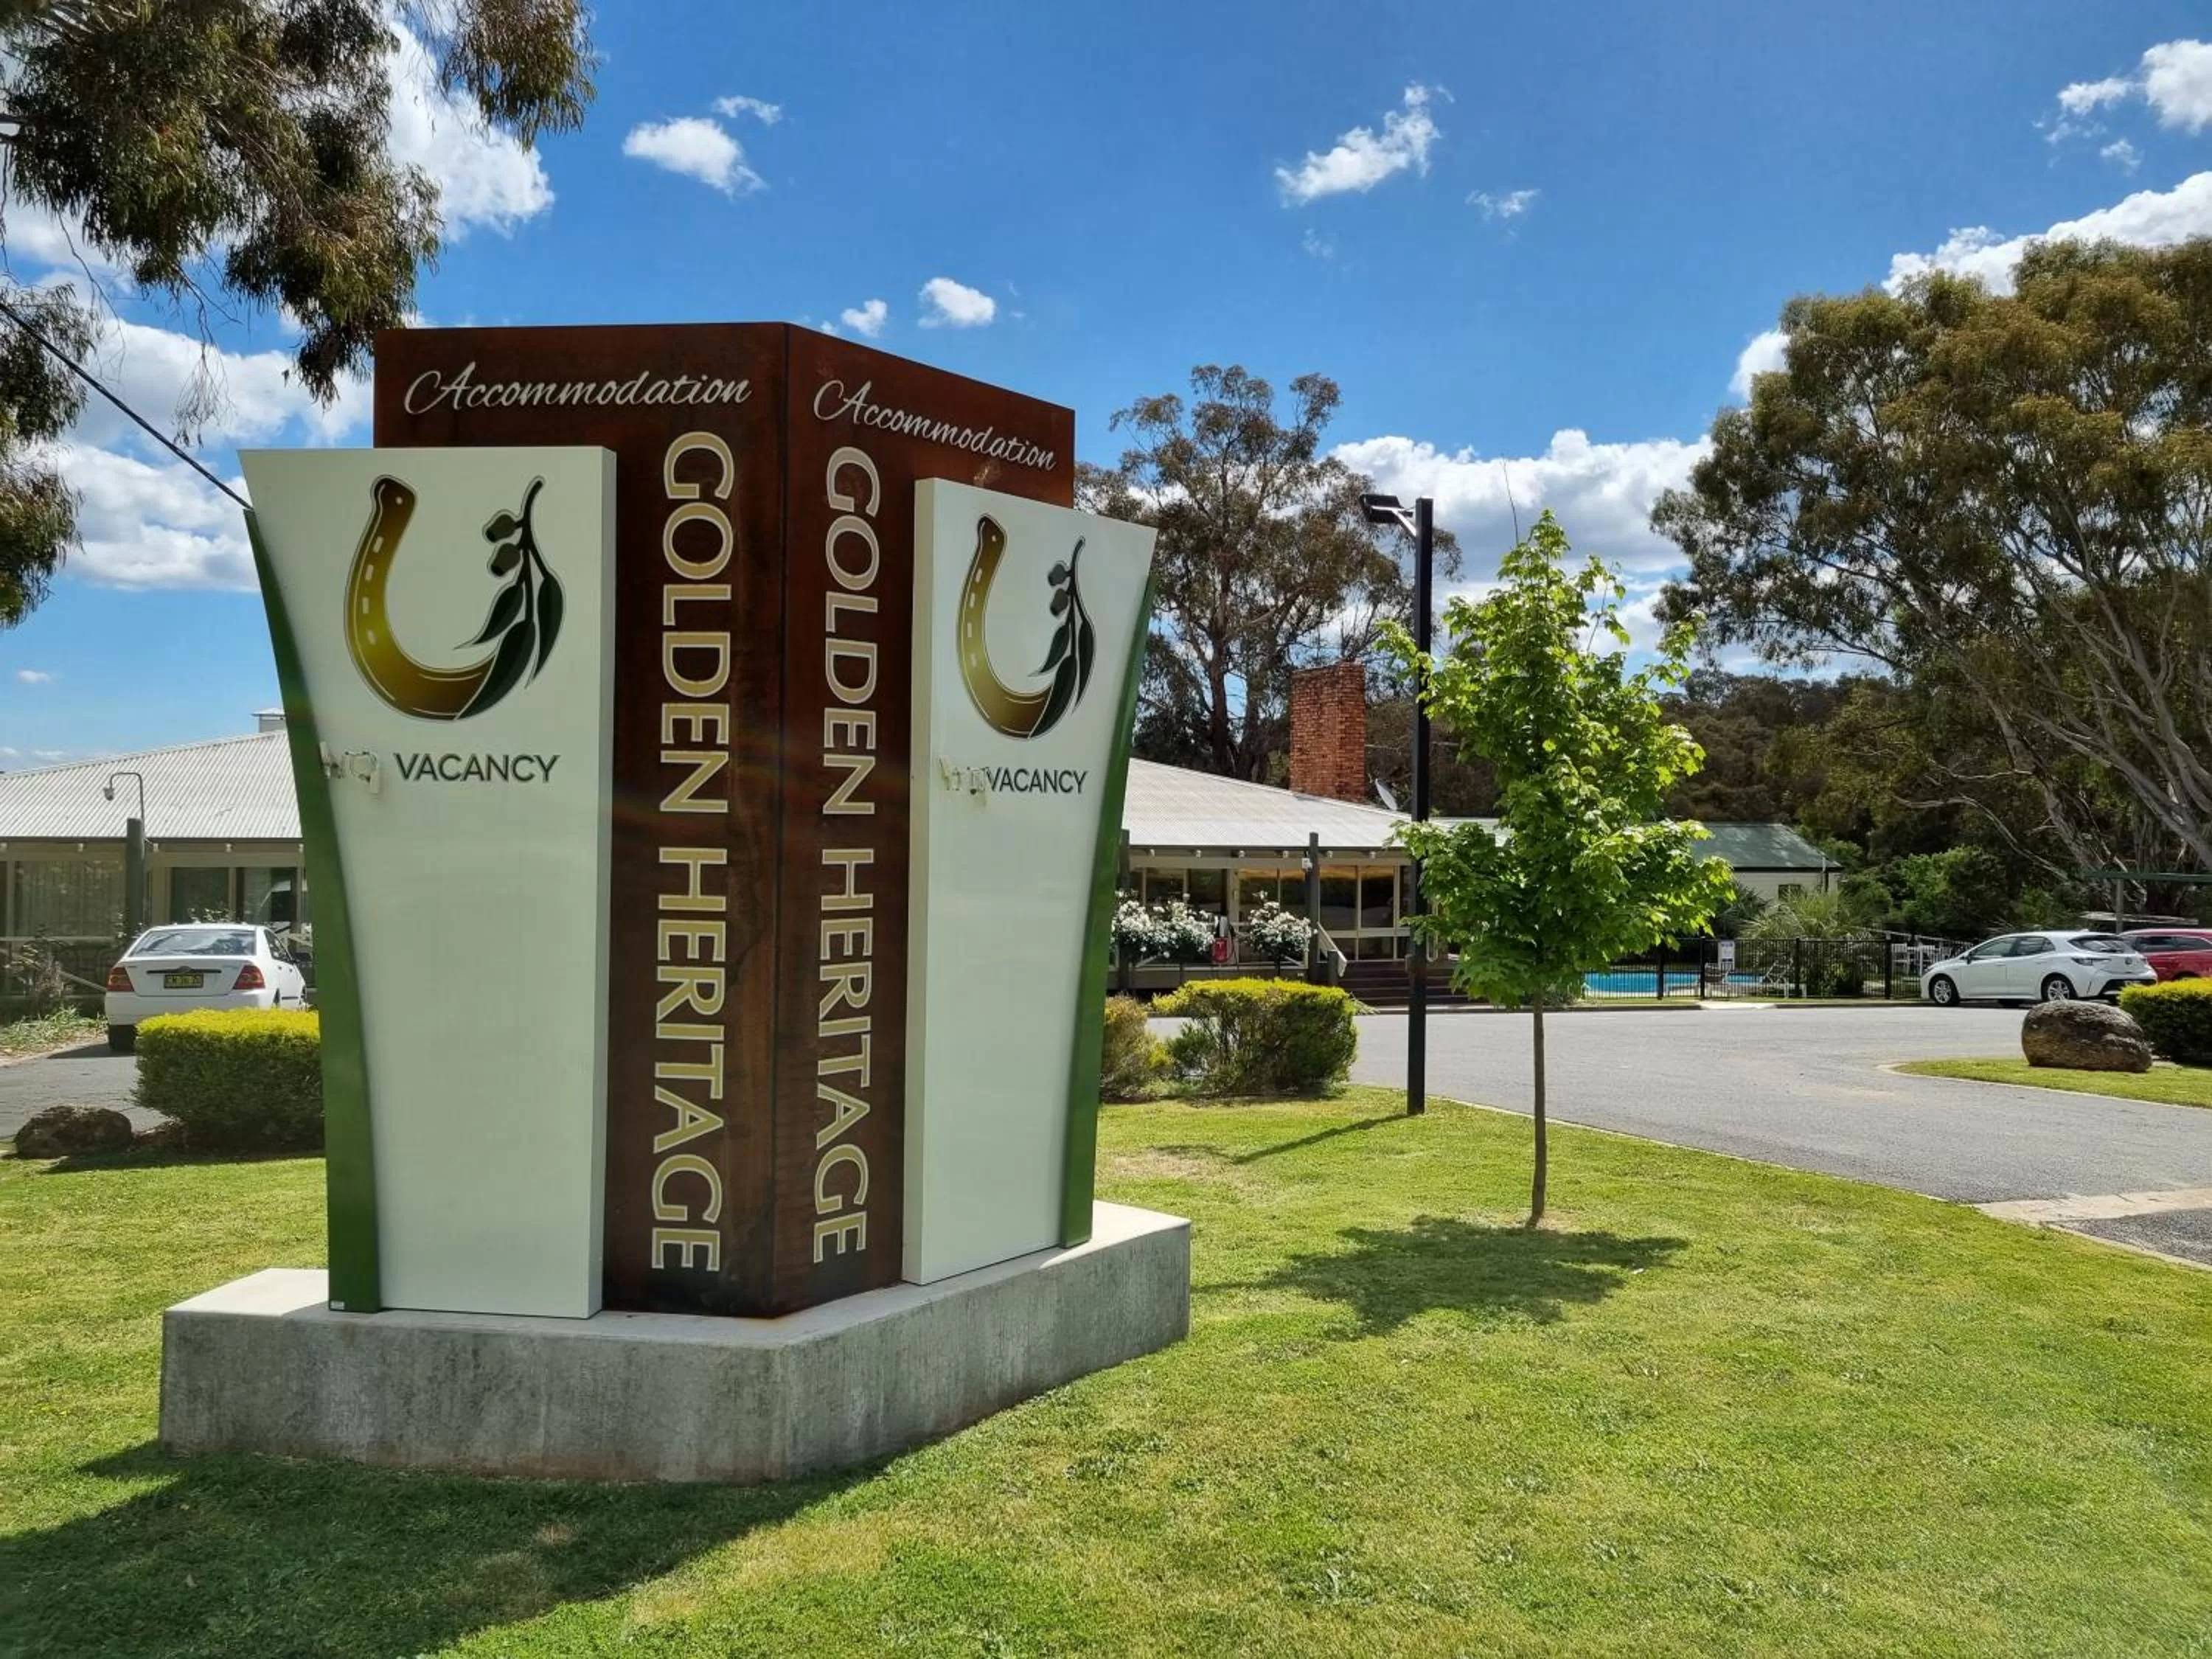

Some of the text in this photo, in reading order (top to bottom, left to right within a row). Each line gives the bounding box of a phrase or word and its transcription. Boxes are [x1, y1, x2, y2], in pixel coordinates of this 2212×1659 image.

[403, 361, 751, 414] Accommodation
[813, 380, 1056, 471] Accommodation
[393, 752, 561, 782] VACANCY
[987, 766, 1088, 794] VACANCY
[651, 431, 734, 1272] GOLDEN HERITAGE
[813, 446, 880, 1264] GOLDEN HERITAGE
